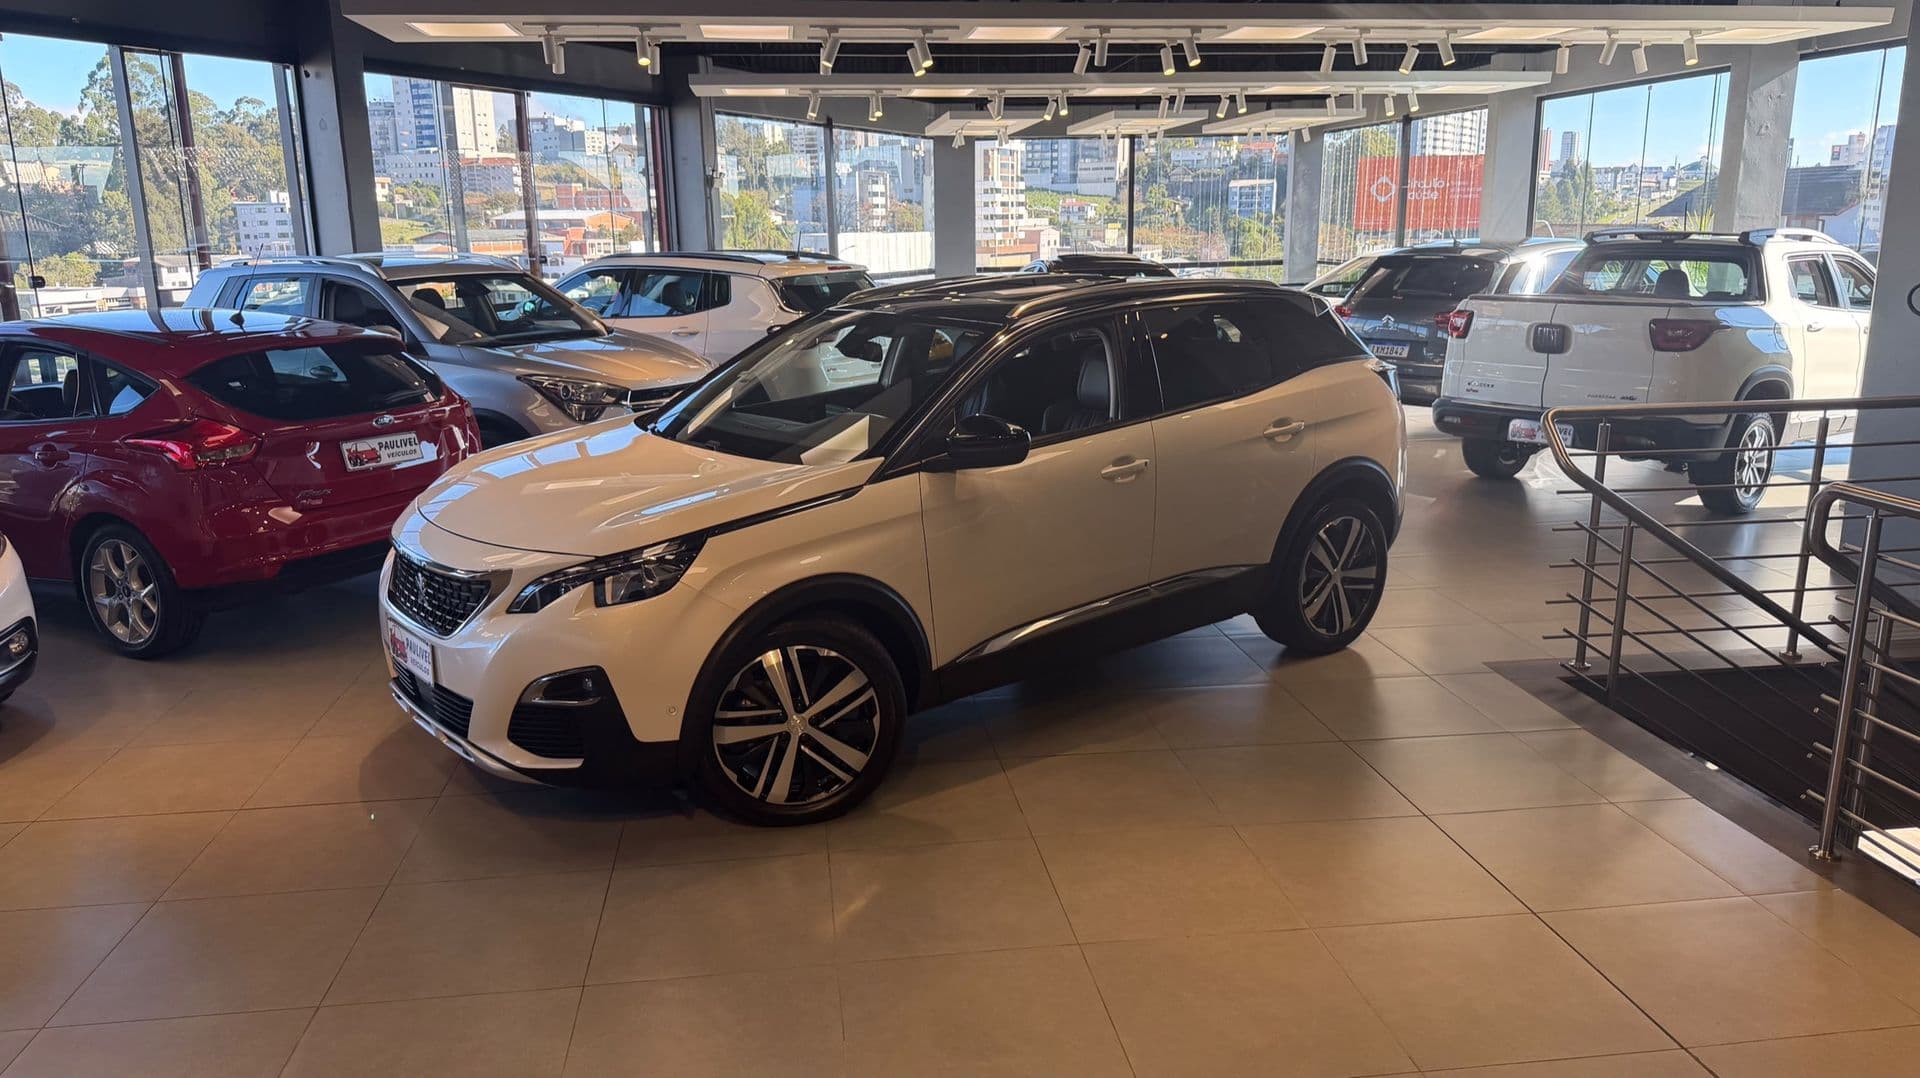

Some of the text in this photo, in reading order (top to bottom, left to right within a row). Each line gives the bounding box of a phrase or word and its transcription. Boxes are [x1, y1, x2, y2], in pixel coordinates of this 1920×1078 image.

[1408, 190, 1439, 200] aúde
[378, 437, 418, 451] PAULIVEL
[387, 448, 417, 459] VEÍCULOS
[406, 637, 430, 665] PAULIVEL
